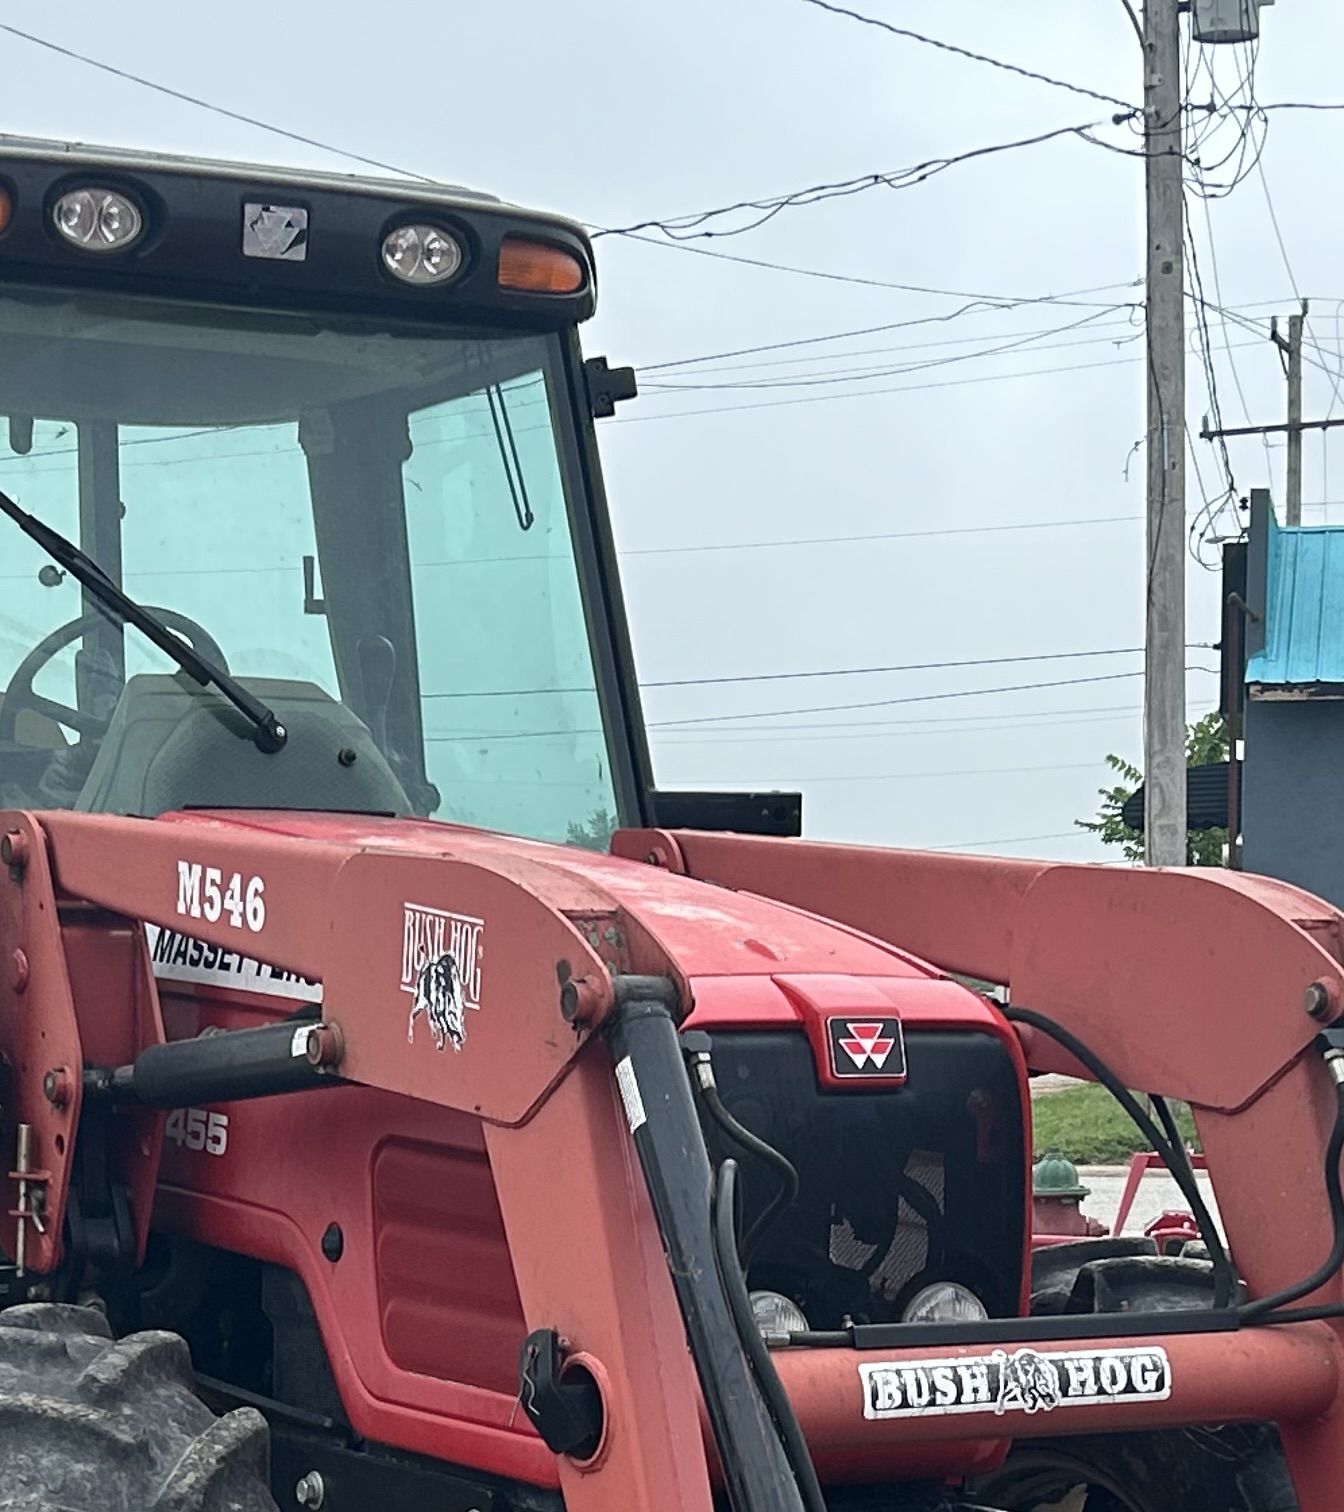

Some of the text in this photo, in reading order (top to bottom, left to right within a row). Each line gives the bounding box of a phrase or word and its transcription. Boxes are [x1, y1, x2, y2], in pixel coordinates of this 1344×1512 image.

[177, 860, 266, 932] M546
[401, 910, 484, 1002] BUSH HOG
[873, 1354, 1162, 1410] BUSH HOG
